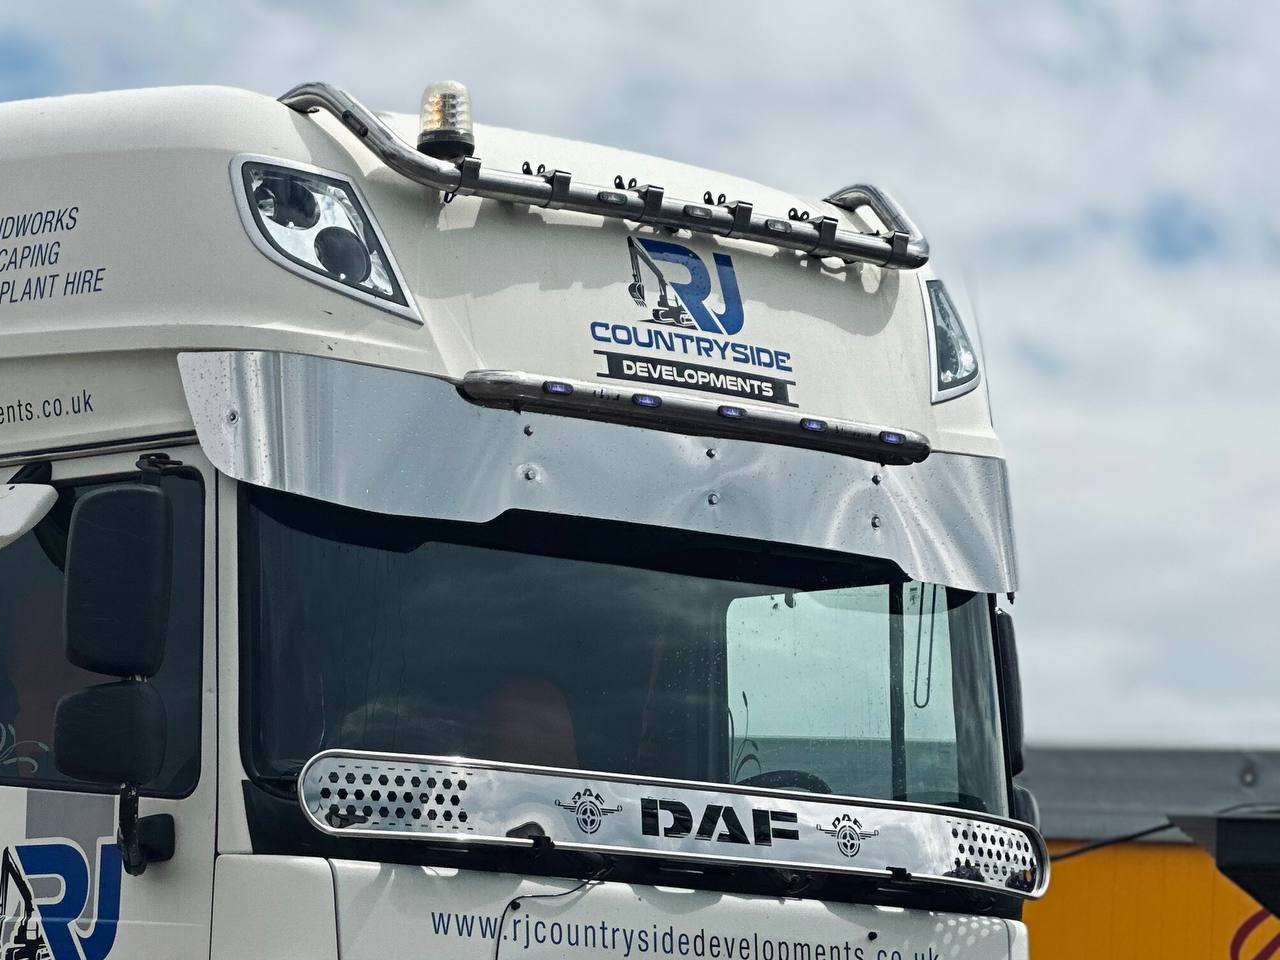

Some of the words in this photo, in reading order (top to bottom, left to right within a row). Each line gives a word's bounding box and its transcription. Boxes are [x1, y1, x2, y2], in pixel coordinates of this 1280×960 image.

[0, 274, 60, 305] PLANT
[63, 268, 106, 295] HIRE
[637, 237, 745, 335] RJ
[590, 321, 793, 372] COUNTRYSIDE
[623, 360, 774, 397] DEVELOPMENTS
[571, 787, 605, 807] DAF
[640, 797, 800, 847] DAF
[831, 813, 863, 832] DAF
